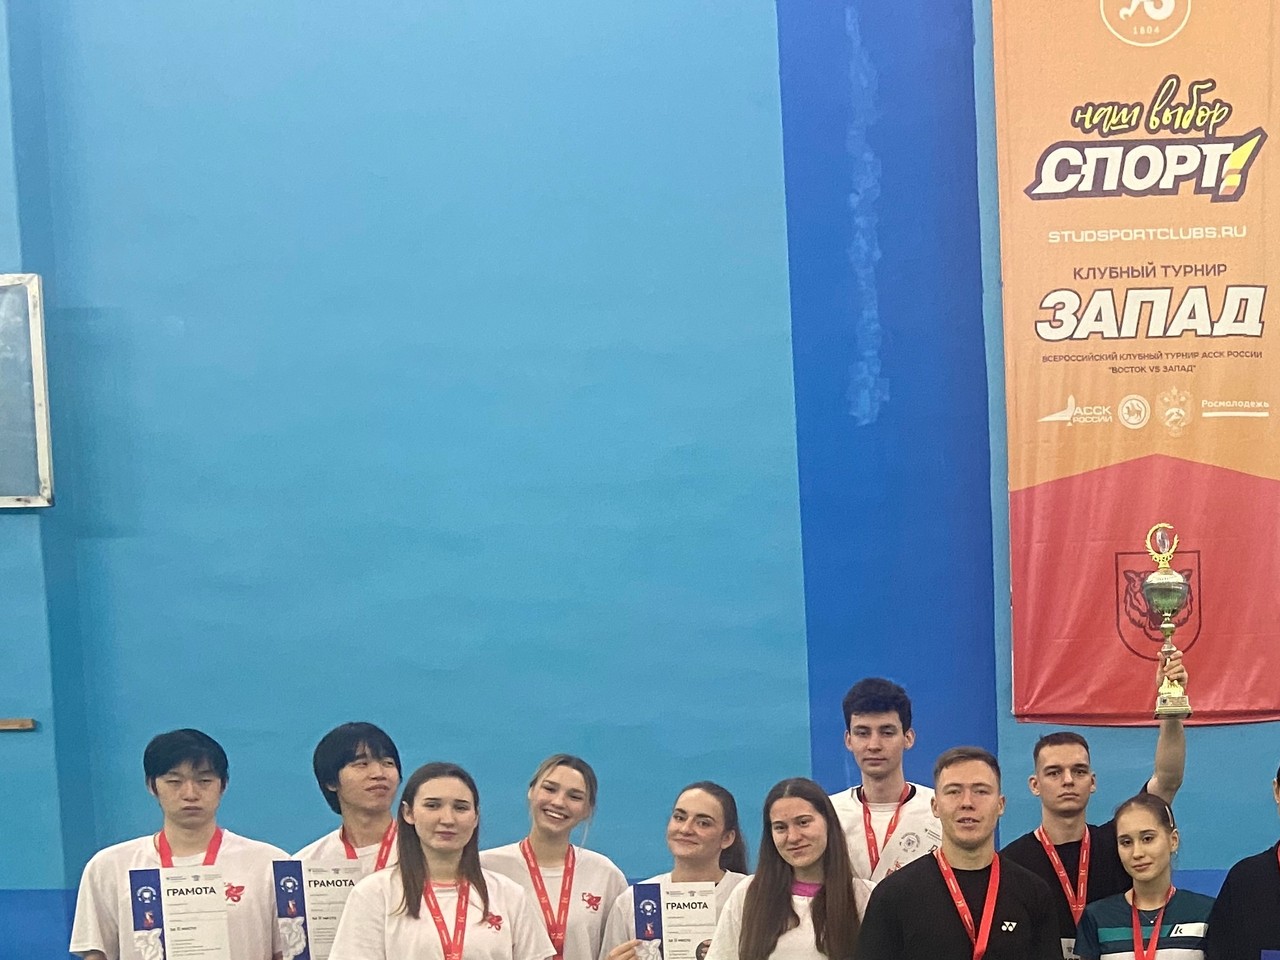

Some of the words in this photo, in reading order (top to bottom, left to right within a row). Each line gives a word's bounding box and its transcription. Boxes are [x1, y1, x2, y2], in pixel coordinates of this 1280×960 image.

[1132, 25, 1160, 36] 1804
[1073, 103, 1141, 134] наш
[1145, 76, 1230, 135] выбор
[1048, 225, 1247, 244] STUDSPORTCLUBS.RU
[1073, 262, 1157, 281] КЛУБНЫЙ
[1160, 263, 1228, 278] ТУРНИР
[1034, 285, 1268, 342] ЗАПАД
[1041, 351, 1118, 363] ВСЕРОССИЙСКИЙ
[1119, 350, 1163, 361] КЛУБНЫЙ
[1165, 351, 1200, 360] ТУРНИР
[1201, 350, 1226, 359] АССК
[1226, 350, 1263, 359] РОССИИ
[1108, 365, 1147, 374] "ВОСТОК
[1148, 365, 1161, 374] VS
[1162, 364, 1197, 374] ЗАПАД"
[1201, 399, 1270, 409] Росмолодежь
[1073, 405, 1112, 416] АССК
[1072, 415, 1113, 424] РОССИИ
[308, 879, 355, 888] ГРАМОТА
[166, 886, 217, 896] ГРАМОТА
[666, 901, 709, 910] ГРАМОТА
